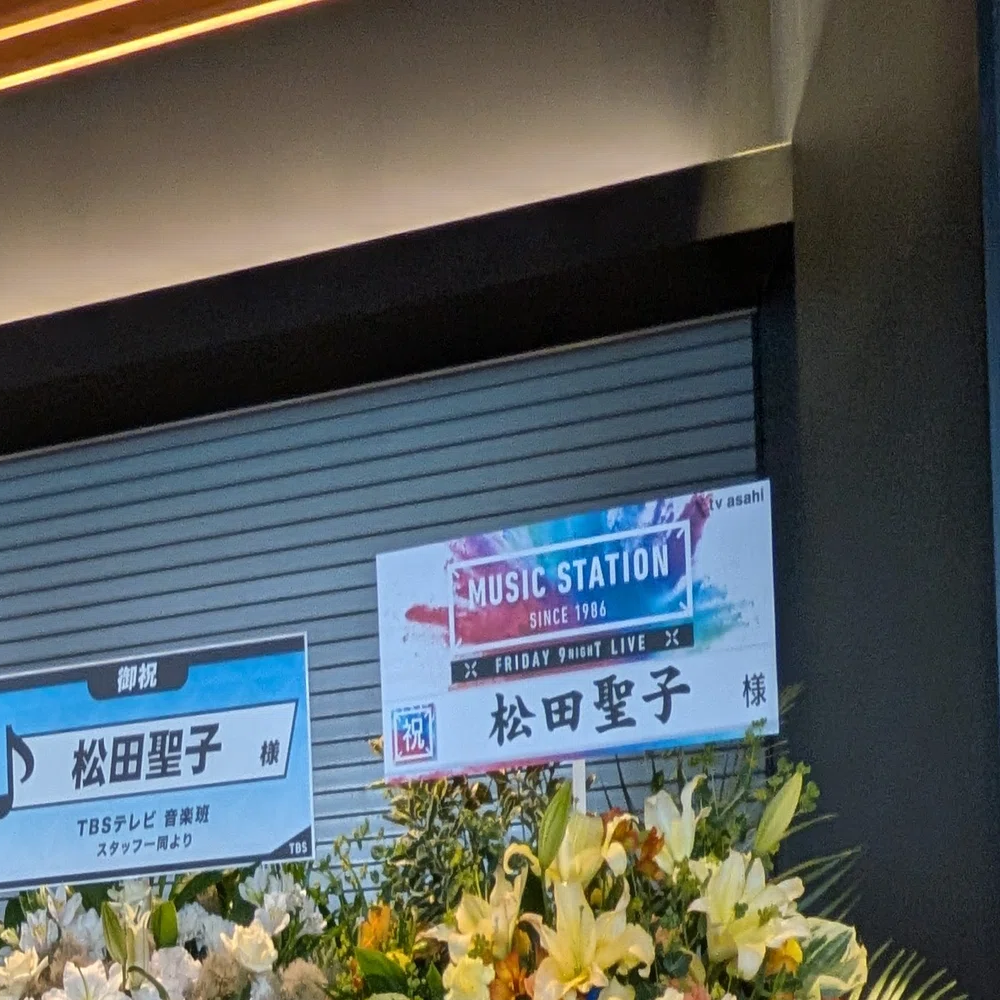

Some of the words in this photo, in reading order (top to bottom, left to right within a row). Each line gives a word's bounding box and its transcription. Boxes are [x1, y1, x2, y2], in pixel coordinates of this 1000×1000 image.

[709, 497, 723, 511] tv
[727, 486, 764, 508] asahi
[468, 567, 546, 609] MUSIC
[557, 544, 669, 595] STATION
[528, 605, 569, 630] SINCE
[575, 600, 607, 622] 1986
[494, 650, 550, 673] FRIDAY
[611, 634, 646, 657] LIVE
[117, 662, 158, 693] 御祝
[489, 665, 691, 747] 松田聖子
[742, 672, 767, 709] 様
[402, 718, 425, 751] 祝
[72, 723, 222, 790] 松田聖子
[259, 740, 280, 767] 様
[77, 809, 157, 837] TBSテレビ
[164, 804, 210, 829] 音楽班
[96, 833, 193, 858] スタッフ一同より
[288, 841, 308, 855] TBS
